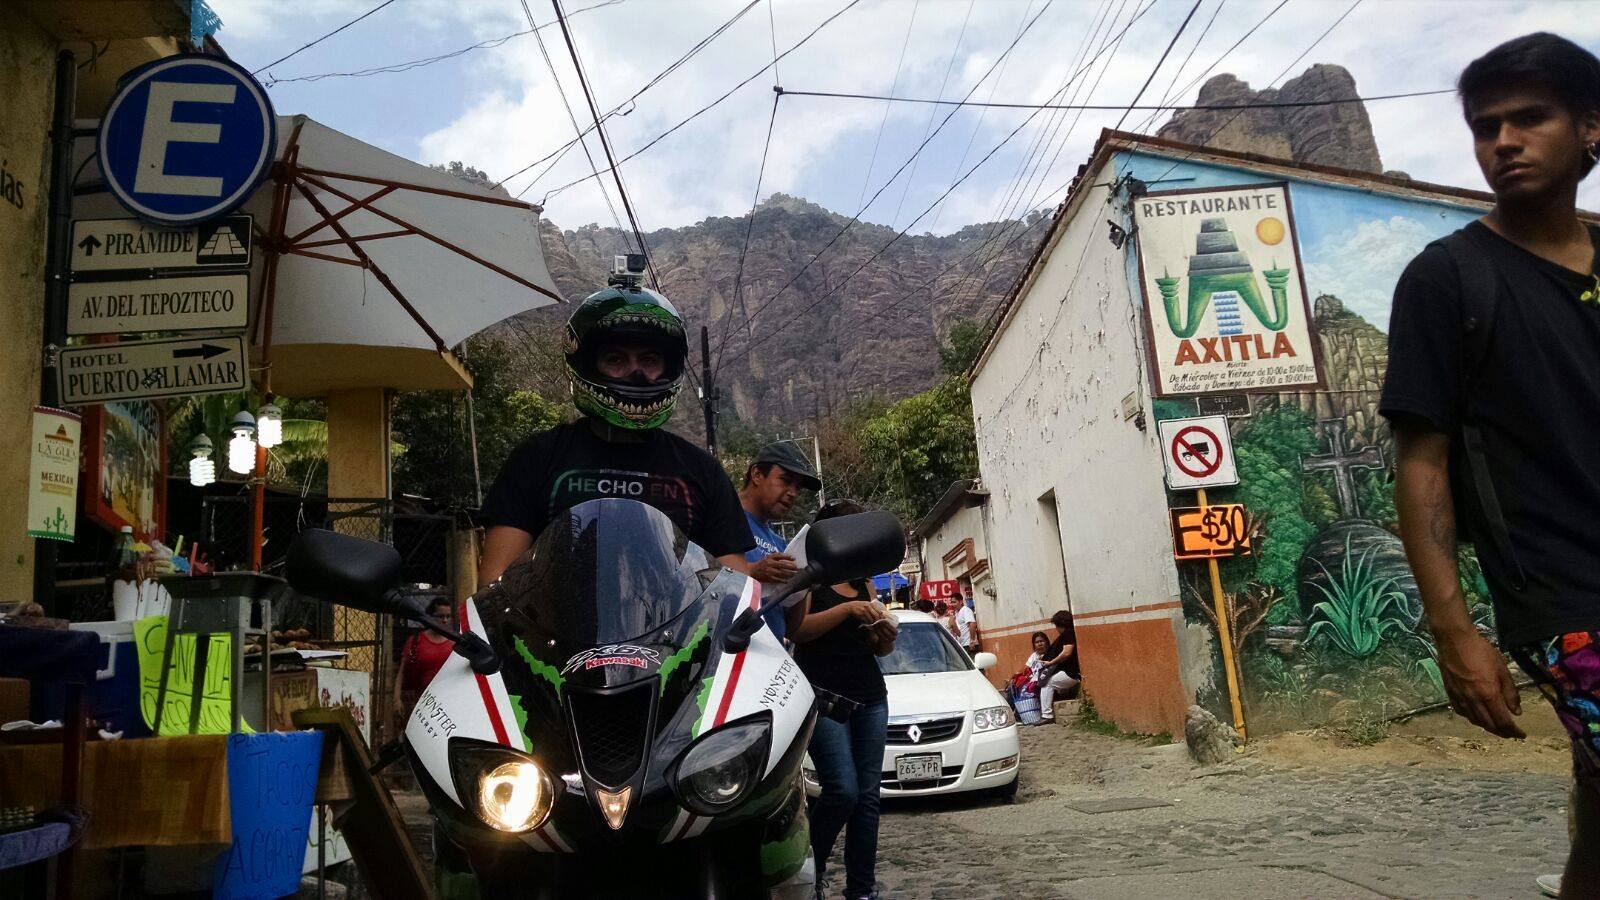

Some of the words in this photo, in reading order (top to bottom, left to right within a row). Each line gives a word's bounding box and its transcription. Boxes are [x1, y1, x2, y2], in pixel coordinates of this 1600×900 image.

[133, 80, 238, 197] E
[1142, 194, 1277, 218] RESTAURANTE
[105, 226, 194, 255] PIRÁMIDE
[81, 297, 103, 319] AV.
[107, 295, 138, 317] DEL
[141, 289, 235, 316] TEPOZTECO
[70, 353, 128, 369] HOTEL
[1173, 332, 1298, 366] AXITLA
[68, 369, 139, 397] PUERTO
[143, 361, 239, 389] VILLAMAR
[1169, 374, 1179, 383] De
[1228, 368, 1256, 378] Viernes
[1257, 368, 1266, 376] de
[1245, 377, 1255, 386] de
[567, 477, 644, 496] HECHO
[650, 483, 678, 500] EN
[1201, 505, 1248, 547] $30
[927, 582, 952, 597] WC
[586, 656, 648, 670] Kawasaki
[779, 674, 800, 707] ENERGY
[415, 708, 438, 738] ENERGY
[900, 761, 939, 775] 265-YPR
